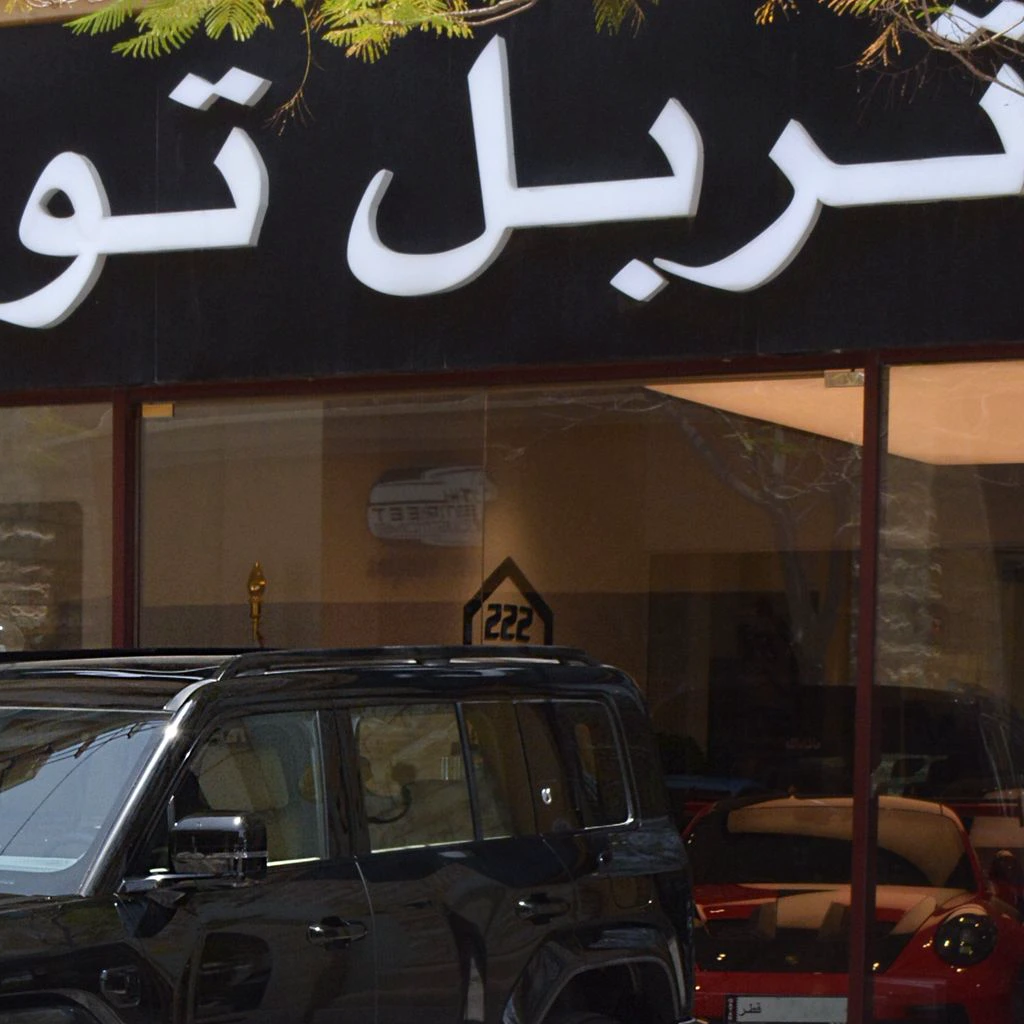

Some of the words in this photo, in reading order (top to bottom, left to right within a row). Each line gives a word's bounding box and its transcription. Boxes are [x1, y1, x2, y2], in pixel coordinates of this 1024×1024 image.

[346, 0, 1024, 301] تربل
[484, 603, 533, 642] 222
[739, 1002, 761, 1017] قطر
